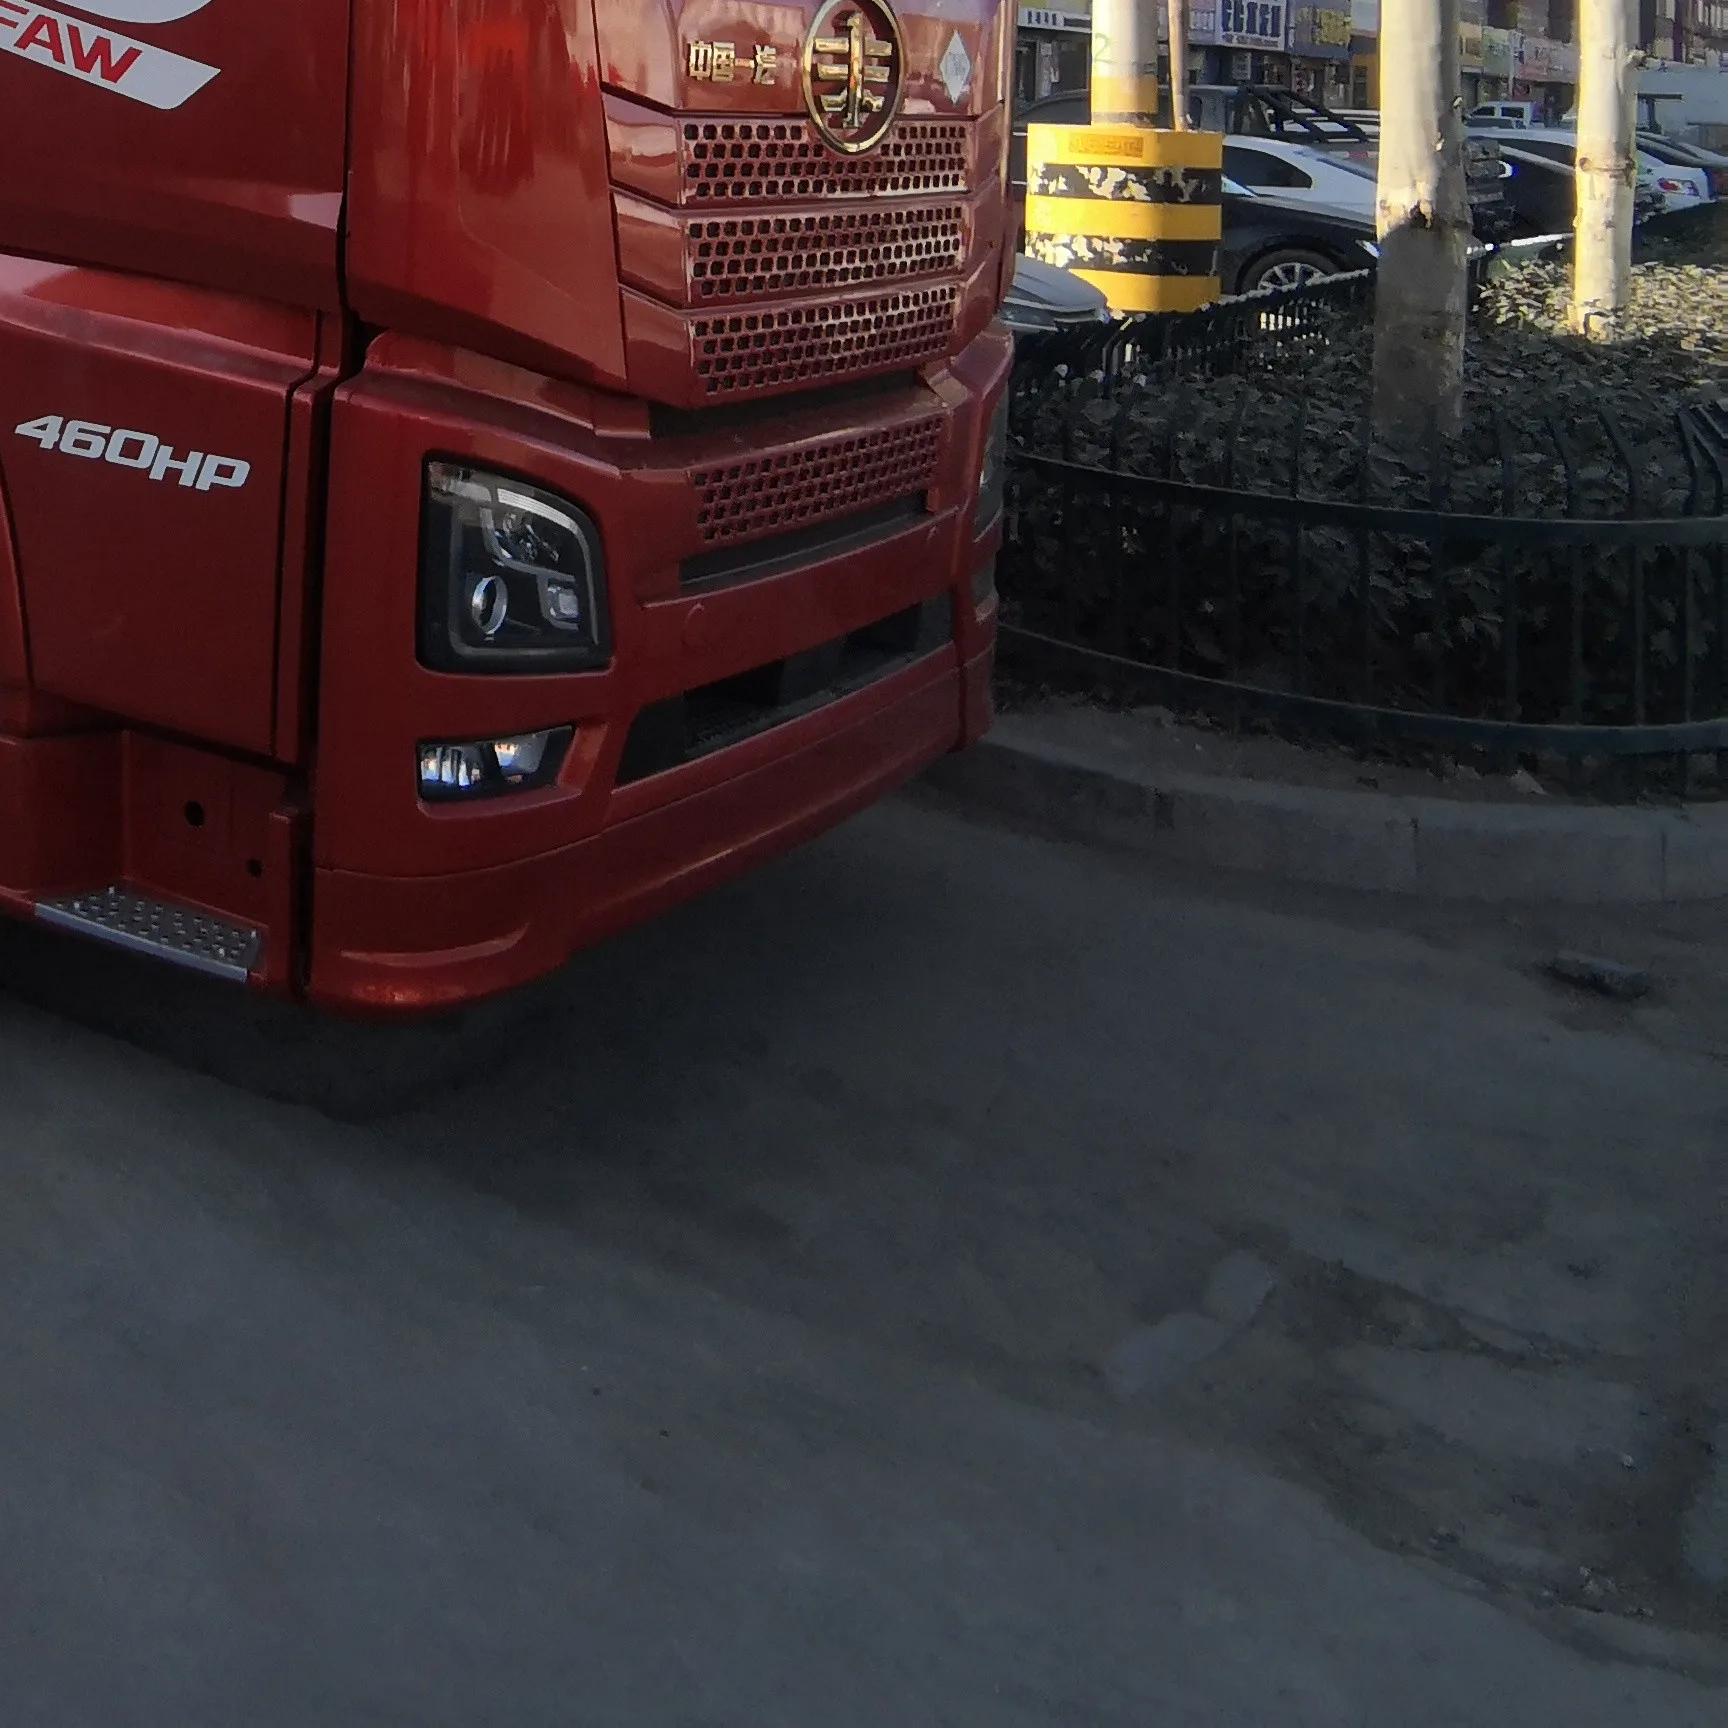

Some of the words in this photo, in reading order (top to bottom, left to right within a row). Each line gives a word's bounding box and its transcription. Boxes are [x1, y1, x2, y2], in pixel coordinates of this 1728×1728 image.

[689, 40, 776, 85] 中国一汽
[15, 415, 251, 491] 460HP
